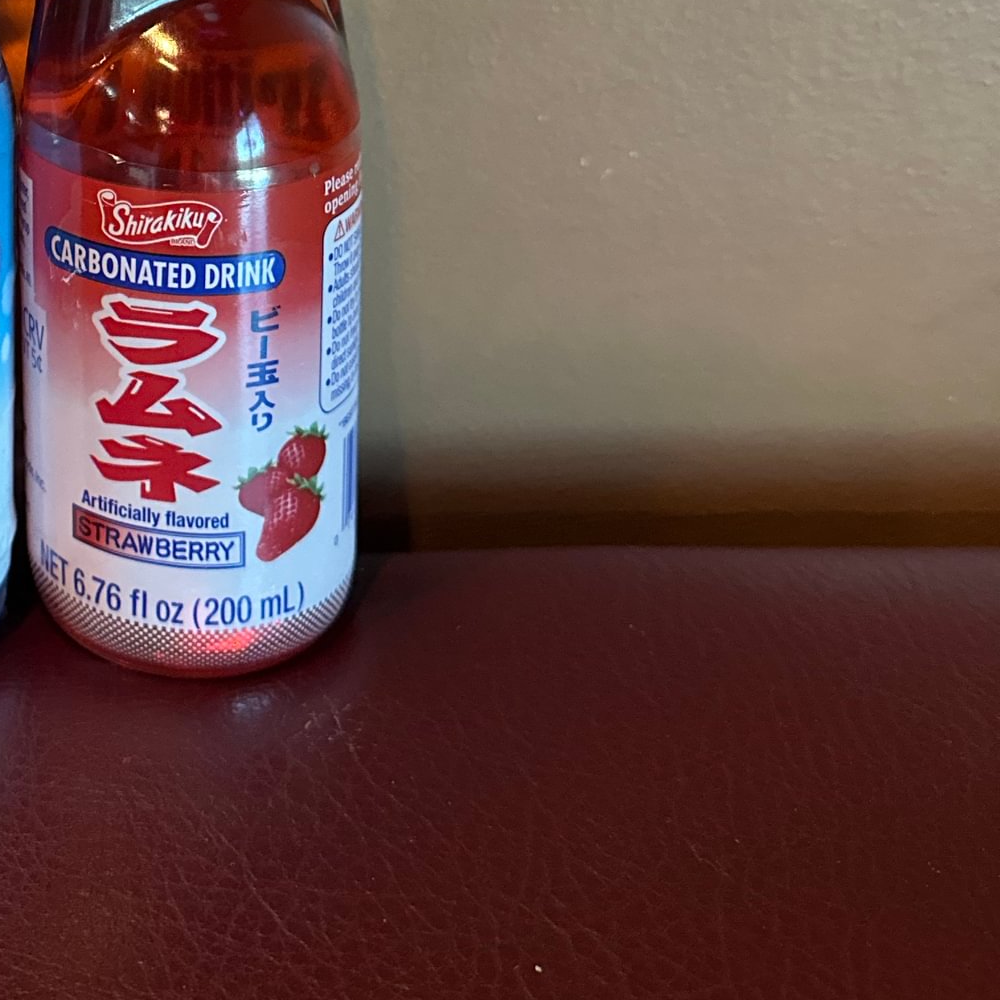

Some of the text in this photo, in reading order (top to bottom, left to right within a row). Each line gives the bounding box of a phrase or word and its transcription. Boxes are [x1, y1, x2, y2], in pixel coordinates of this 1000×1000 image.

[324, 168, 354, 196] Please
[108, 203, 204, 236] Shirakiku
[50, 234, 275, 290] CARBONATED DRINK
[246, 304, 281, 432] ビー玉入り
[89, 300, 223, 503] ラムネ
[81, 489, 229, 529] Artificially flavored
[78, 516, 235, 562] STRAWBERRY
[40, 538, 305, 629] NET 6.76 fl oz (200 mL)
